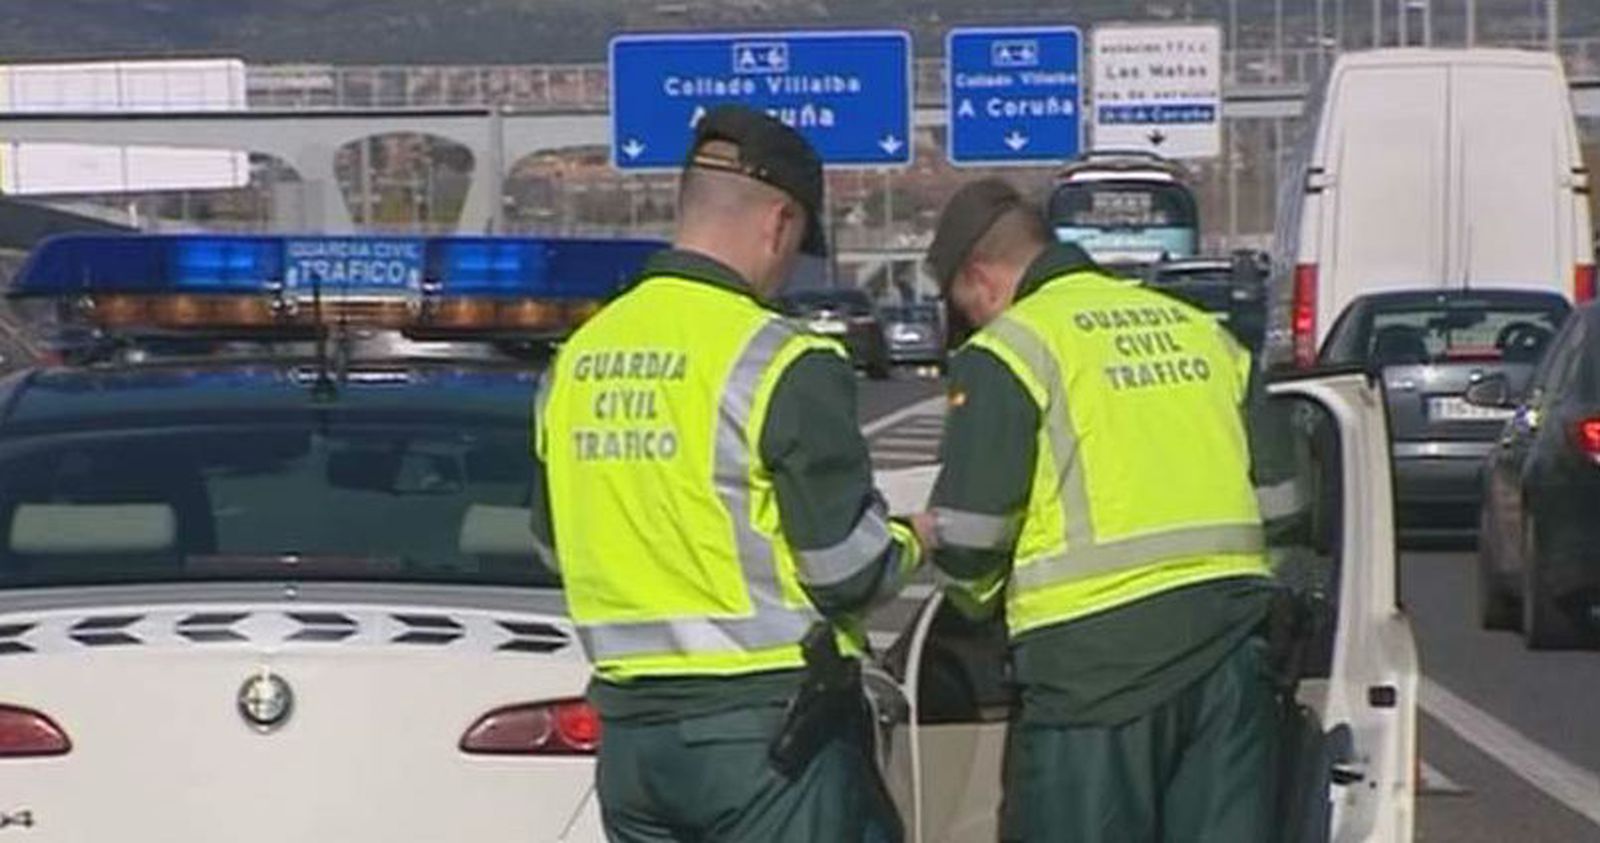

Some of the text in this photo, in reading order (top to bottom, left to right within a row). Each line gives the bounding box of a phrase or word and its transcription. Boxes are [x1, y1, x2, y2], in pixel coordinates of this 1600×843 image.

[663, 74, 861, 96] Collado Villalba
[958, 95, 1074, 117] A Coruña
[1073, 306, 1192, 332] GUARDIA
[1114, 331, 1182, 357] CIVIL
[574, 351, 687, 382] GUARDIA
[1104, 357, 1211, 390] TRAFICO
[594, 390, 657, 421] CIVIL
[575, 431, 677, 461] TRAFICO
